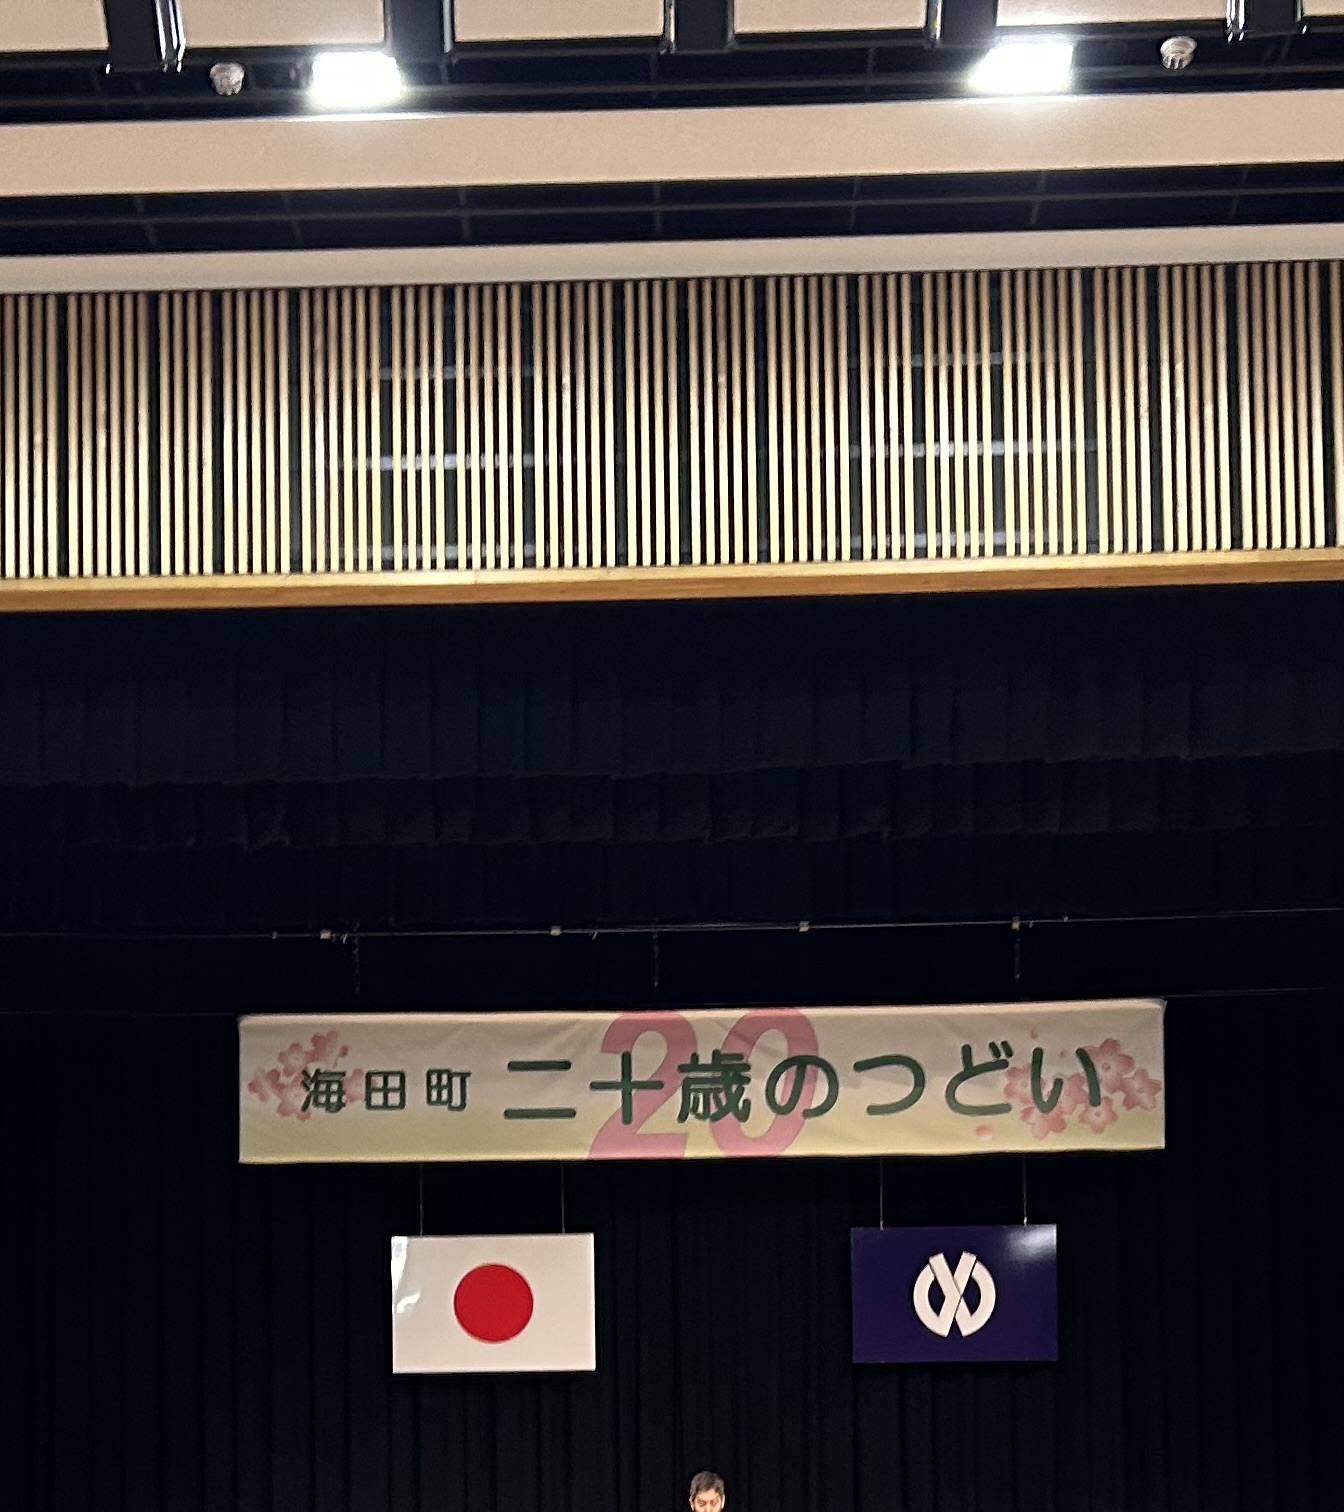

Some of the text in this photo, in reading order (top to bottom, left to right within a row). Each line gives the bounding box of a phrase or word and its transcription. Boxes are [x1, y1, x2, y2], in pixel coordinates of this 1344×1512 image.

[300, 1039, 1104, 1126] 海田町 二十歳のつどい
[587, 1008, 817, 1162] 20
